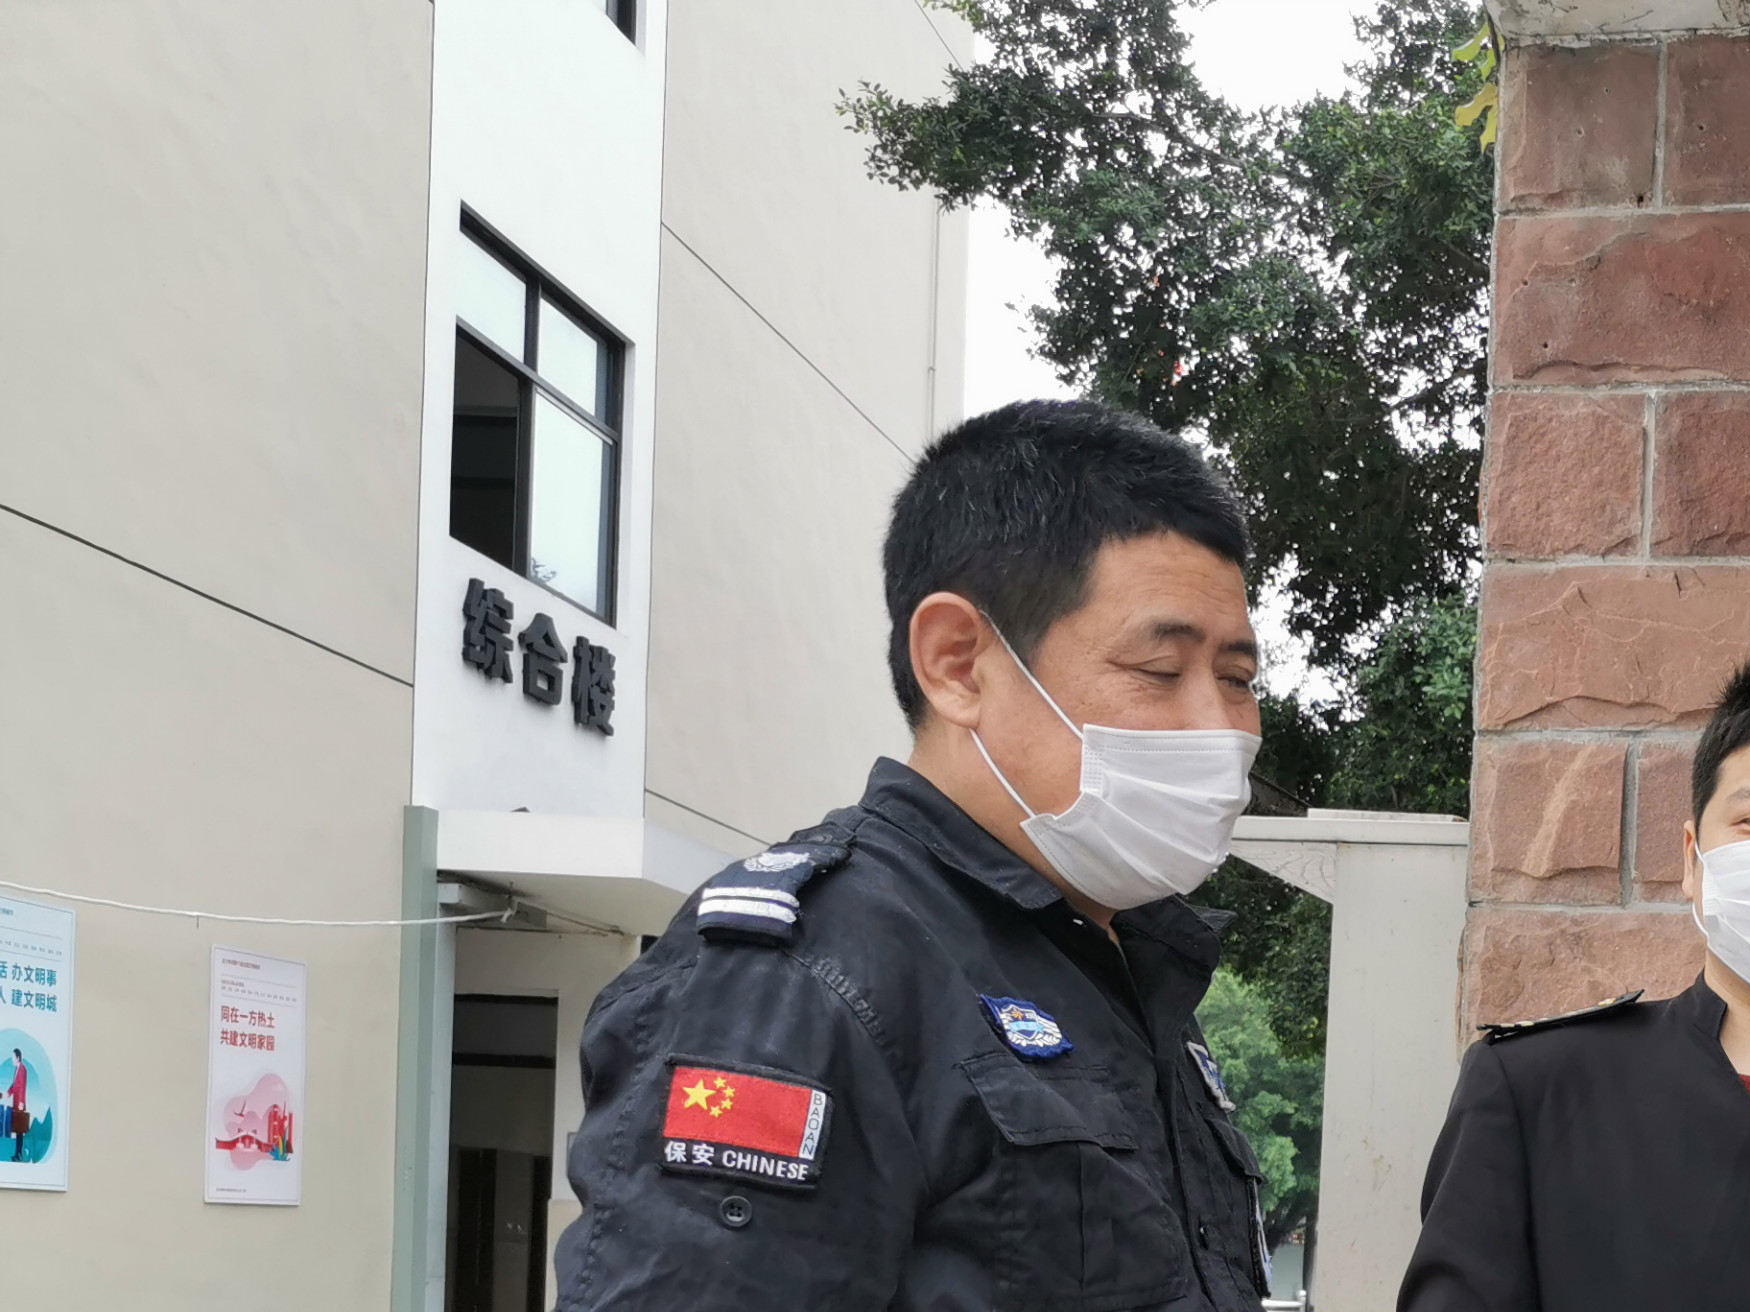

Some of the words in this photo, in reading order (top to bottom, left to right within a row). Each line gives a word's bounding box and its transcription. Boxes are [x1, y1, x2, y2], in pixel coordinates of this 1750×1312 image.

[462, 577, 616, 737] 综合楼
[11, 963, 57, 987] 办文明事
[11, 988, 57, 1013] 建文明城
[221, 1005, 275, 1029] 同在一方热土
[220, 1028, 275, 1051] 共建文明家园
[802, 1093, 823, 1155] BAOAN
[664, 1141, 714, 1165] 保安
[722, 1150, 809, 1180] CHINESE
